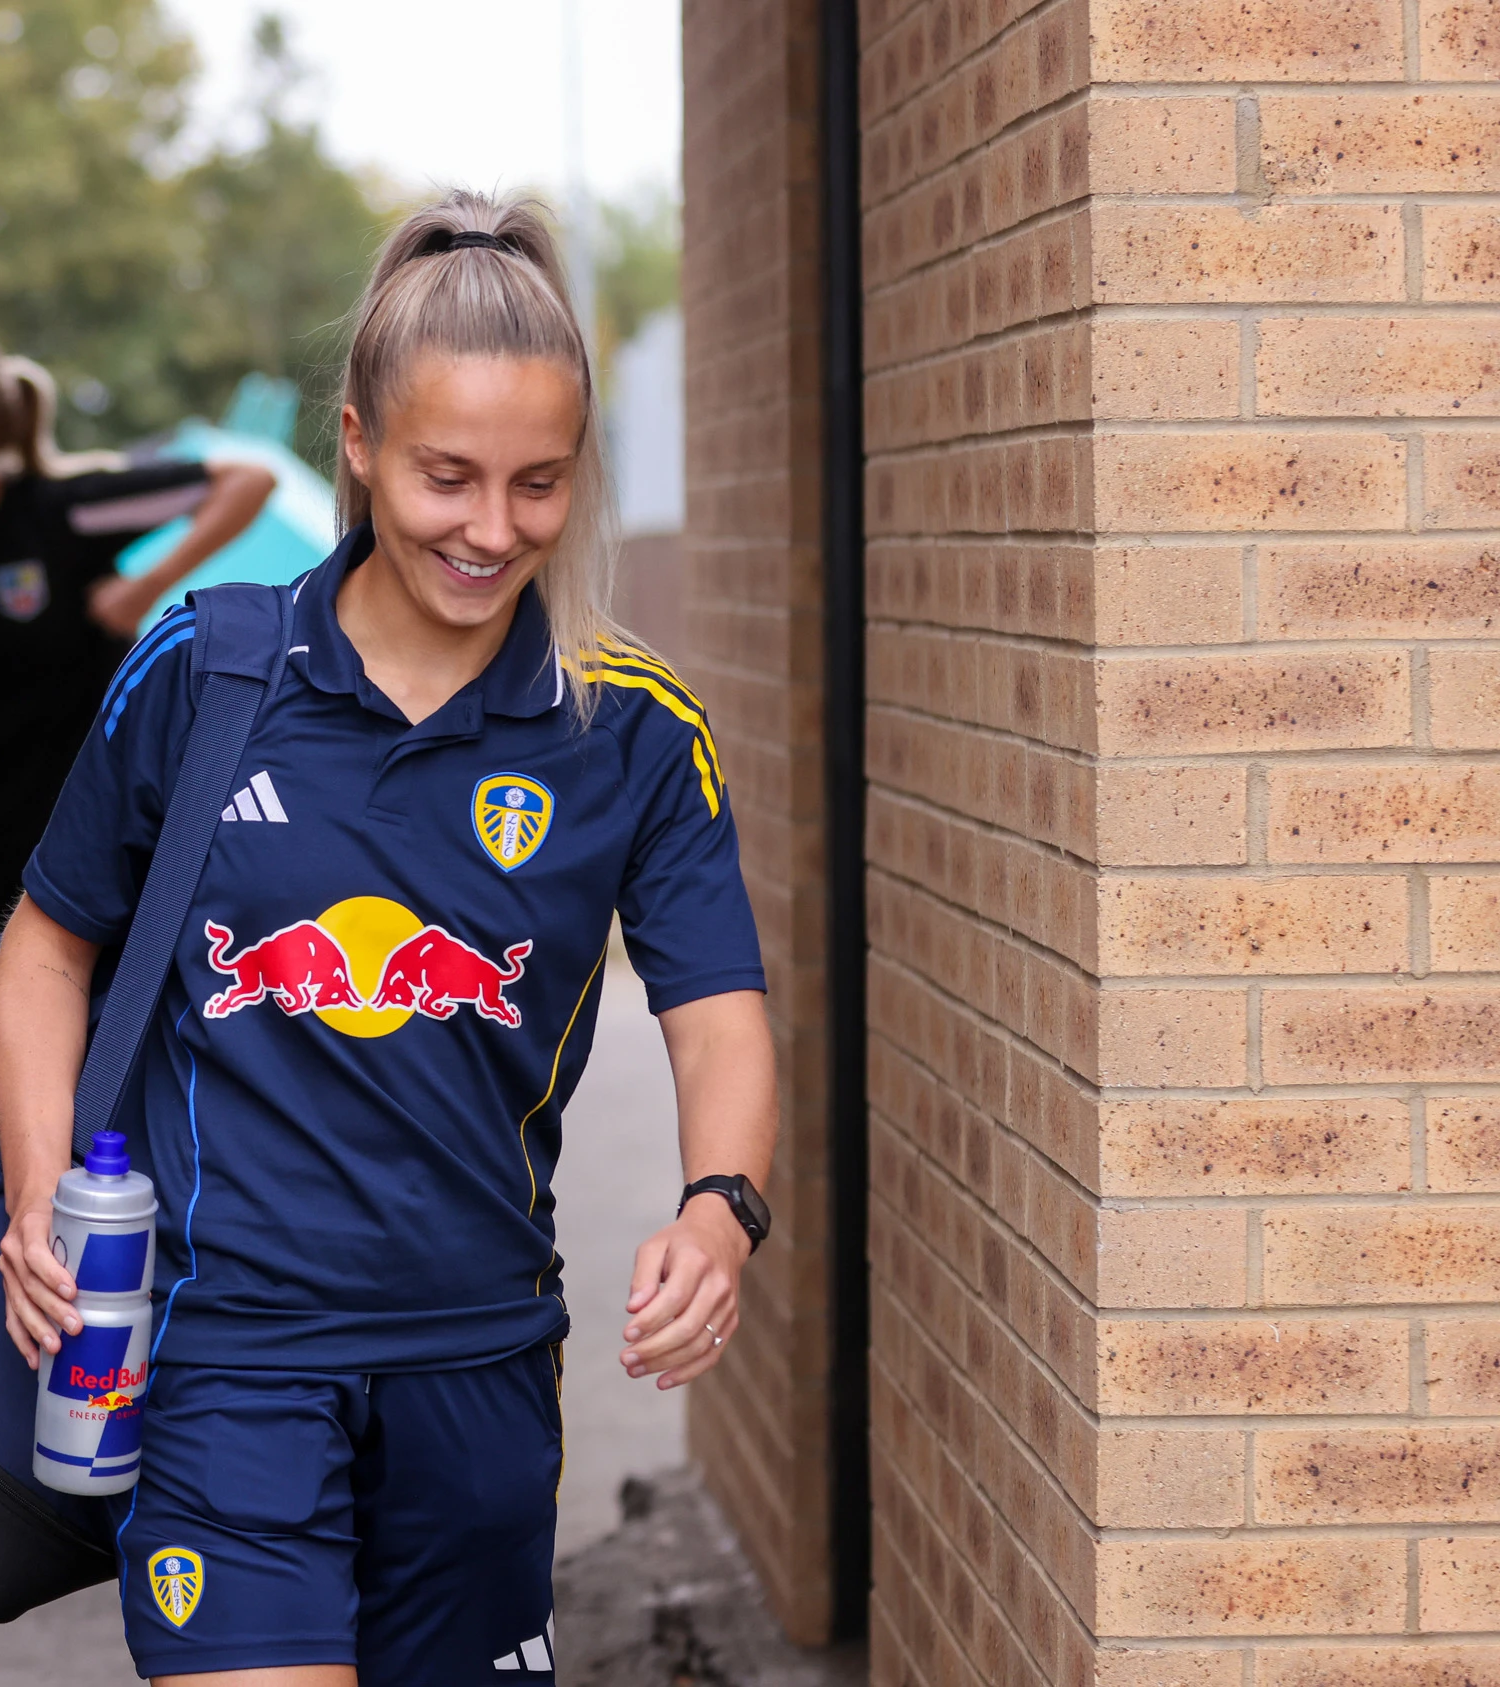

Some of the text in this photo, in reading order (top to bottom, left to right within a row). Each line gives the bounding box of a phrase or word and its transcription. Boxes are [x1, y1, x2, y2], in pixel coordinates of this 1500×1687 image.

[504, 814, 518, 857] LUFC
[70, 1361, 147, 1389] Red Bull
[69, 1409, 113, 1421] ENERGY
